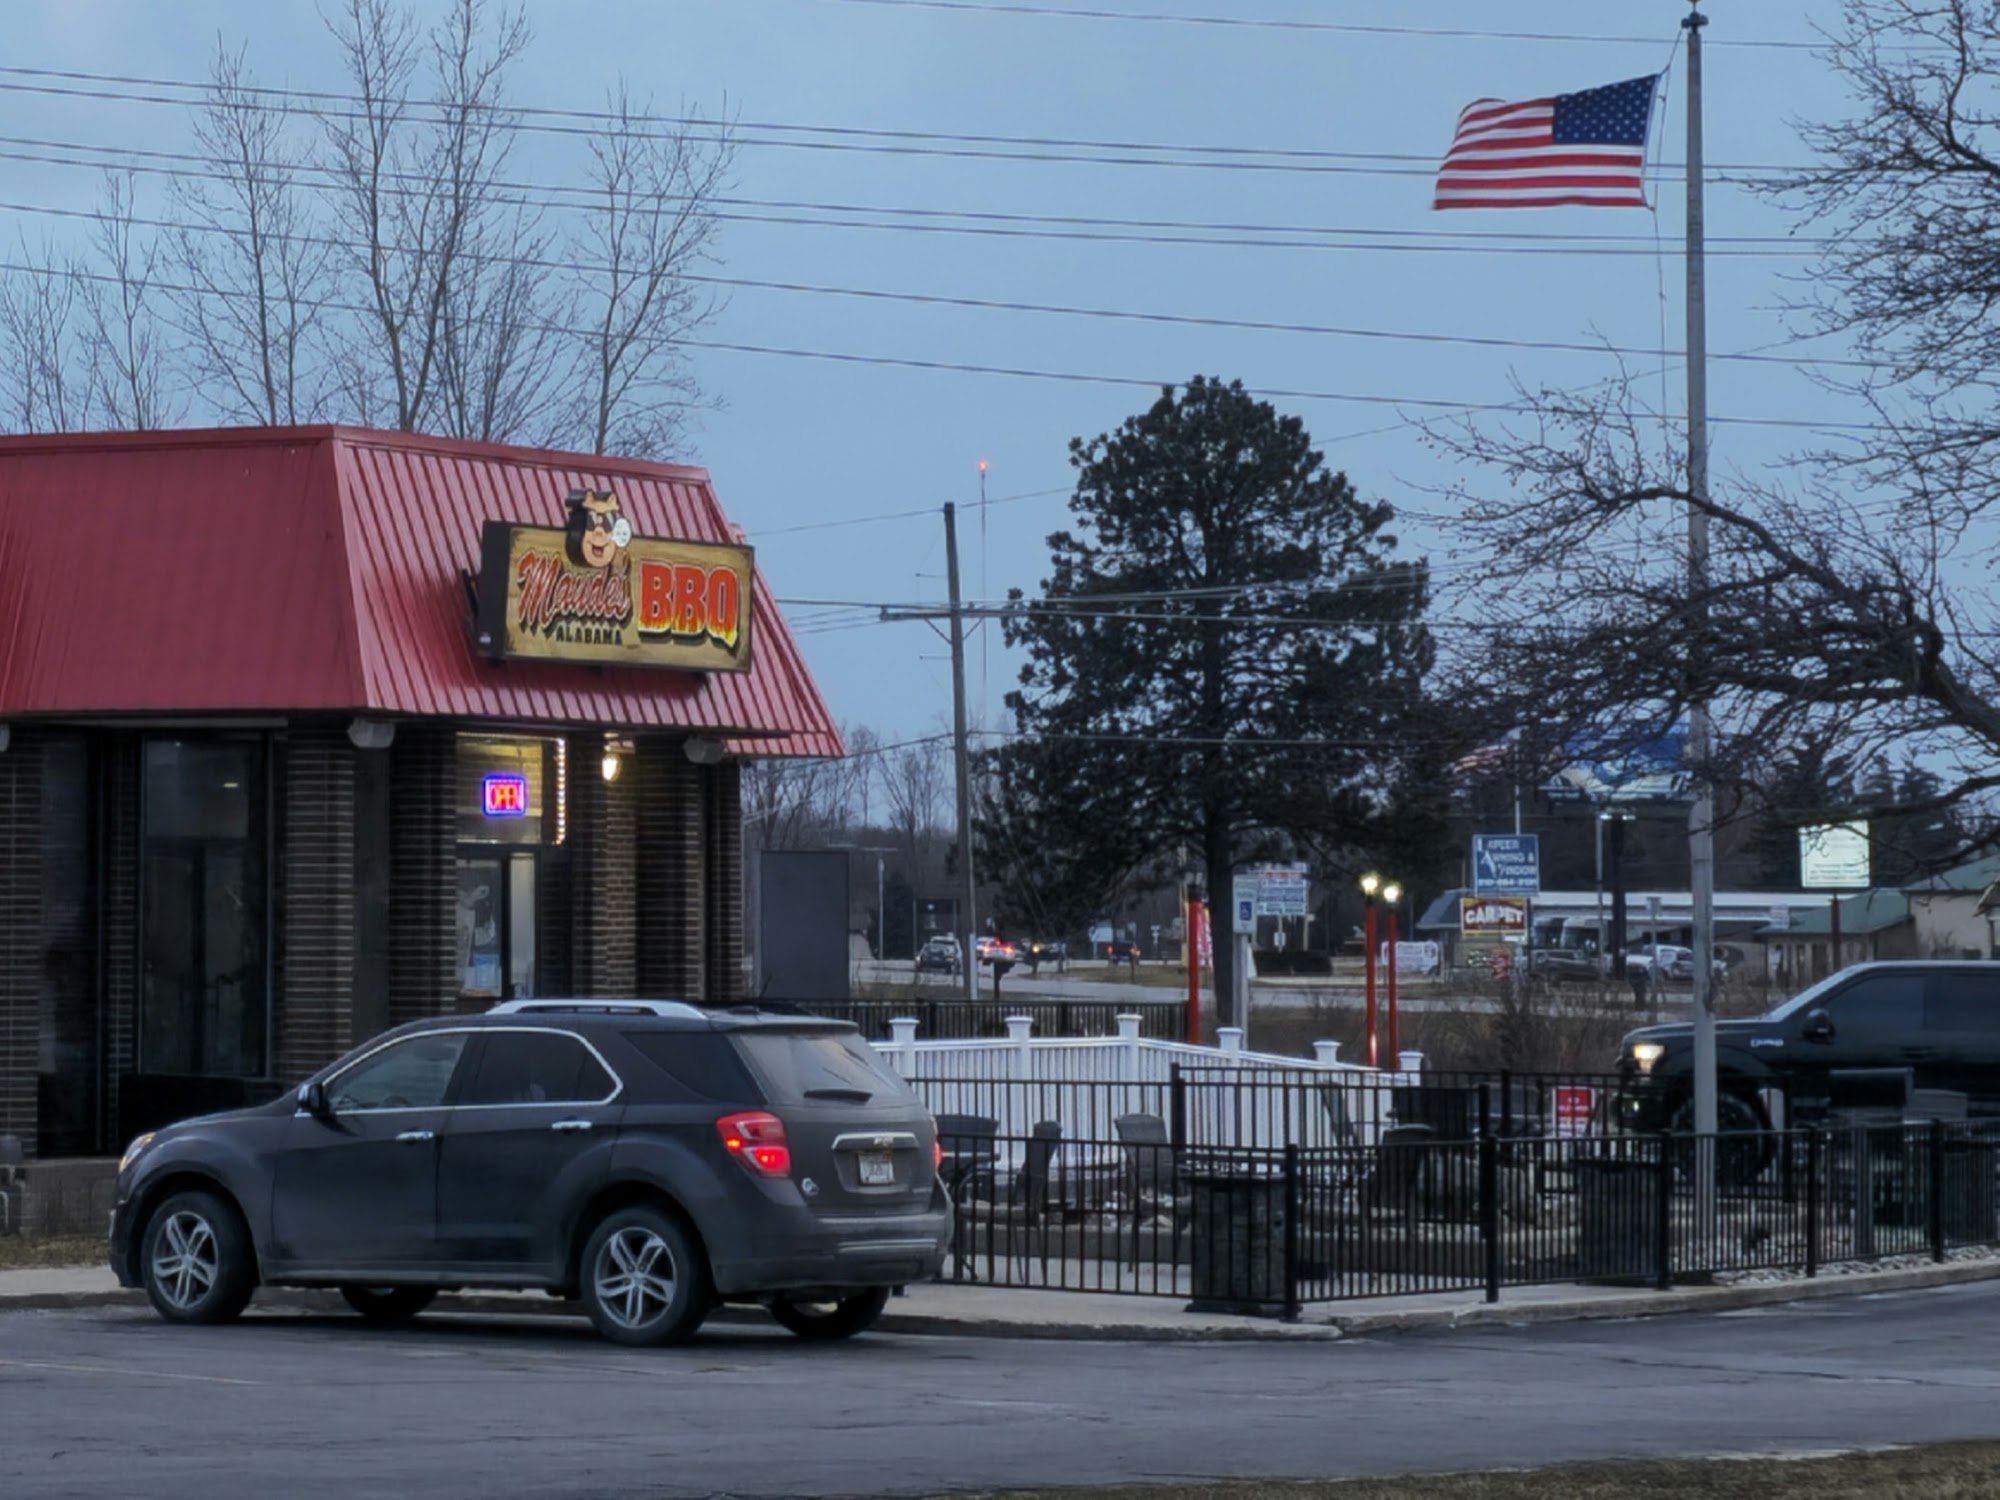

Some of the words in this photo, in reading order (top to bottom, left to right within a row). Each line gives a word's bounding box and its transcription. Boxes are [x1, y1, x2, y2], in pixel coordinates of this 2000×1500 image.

[637, 560, 739, 648] BBQ
[555, 625, 623, 646] ALABAMA
[1465, 905, 1524, 925] CARPET
